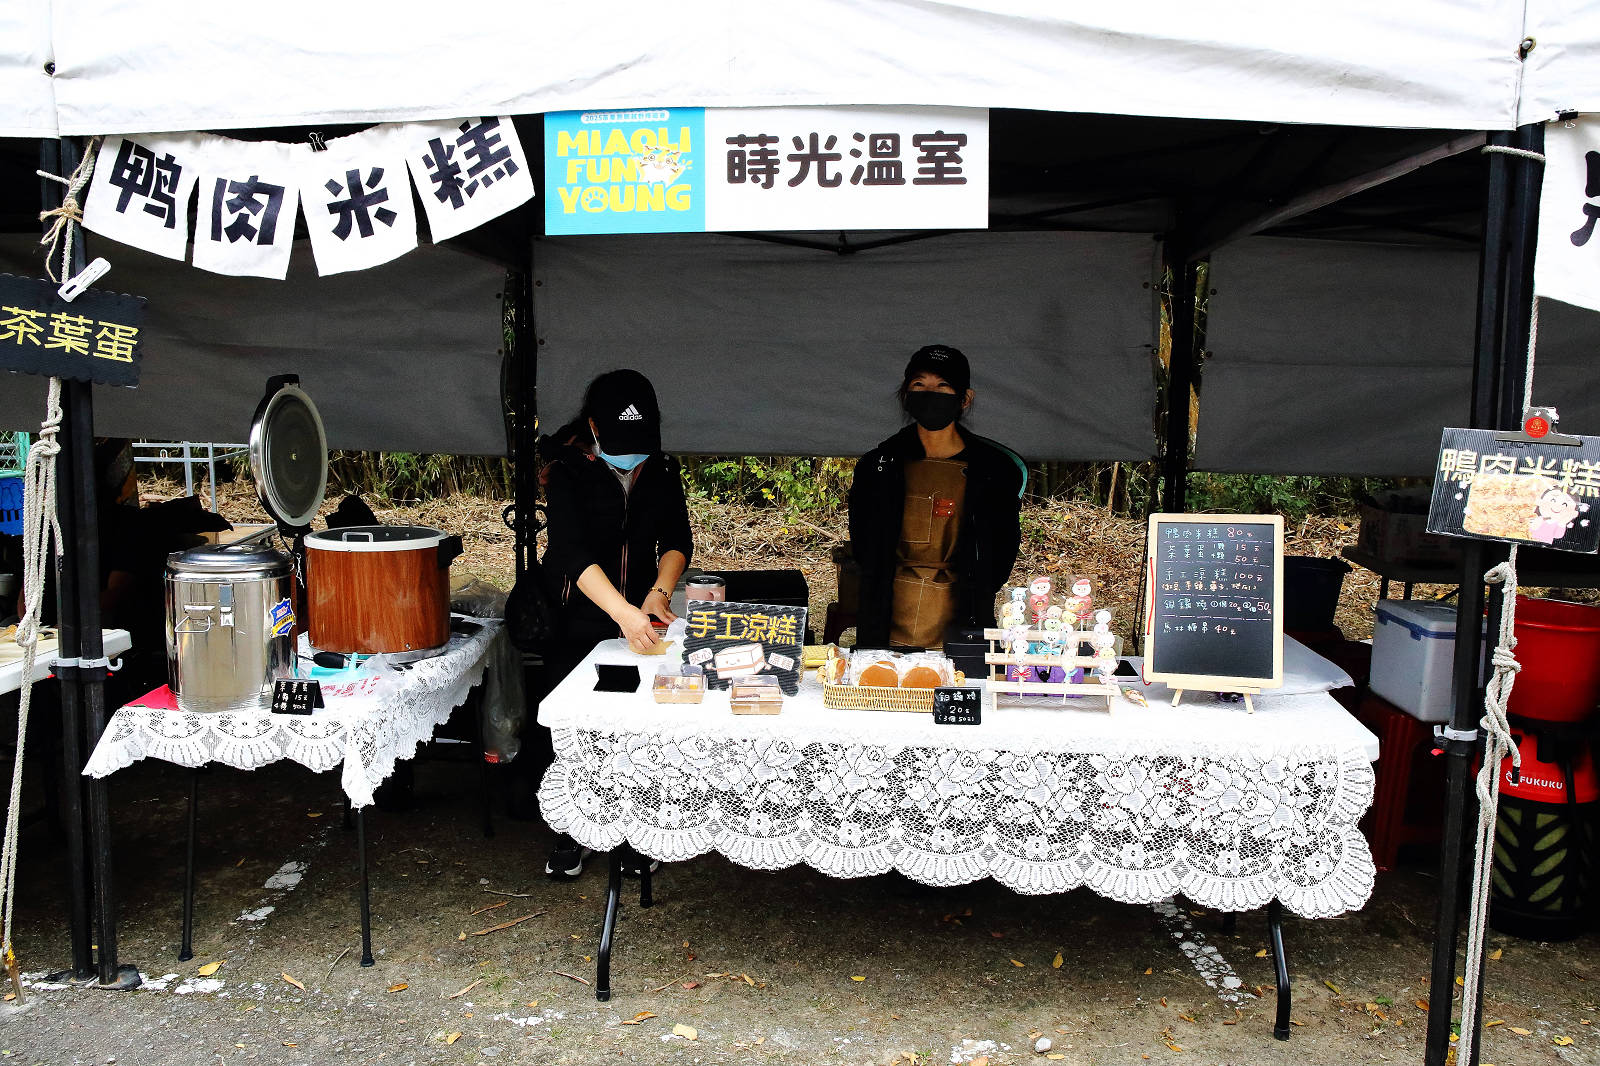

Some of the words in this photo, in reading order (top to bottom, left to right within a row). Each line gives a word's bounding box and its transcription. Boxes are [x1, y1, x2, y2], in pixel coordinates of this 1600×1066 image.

[556, 126, 692, 157] MIAOLI
[566, 157, 638, 185] FUN
[725, 129, 968, 190] 蒔光溫室
[557, 184, 692, 214] YOUNG
[0, 306, 140, 364] 茶葉蛋
[689, 610, 798, 646] 手工涼糕
[1519, 775, 1563, 790] FUKUKU
